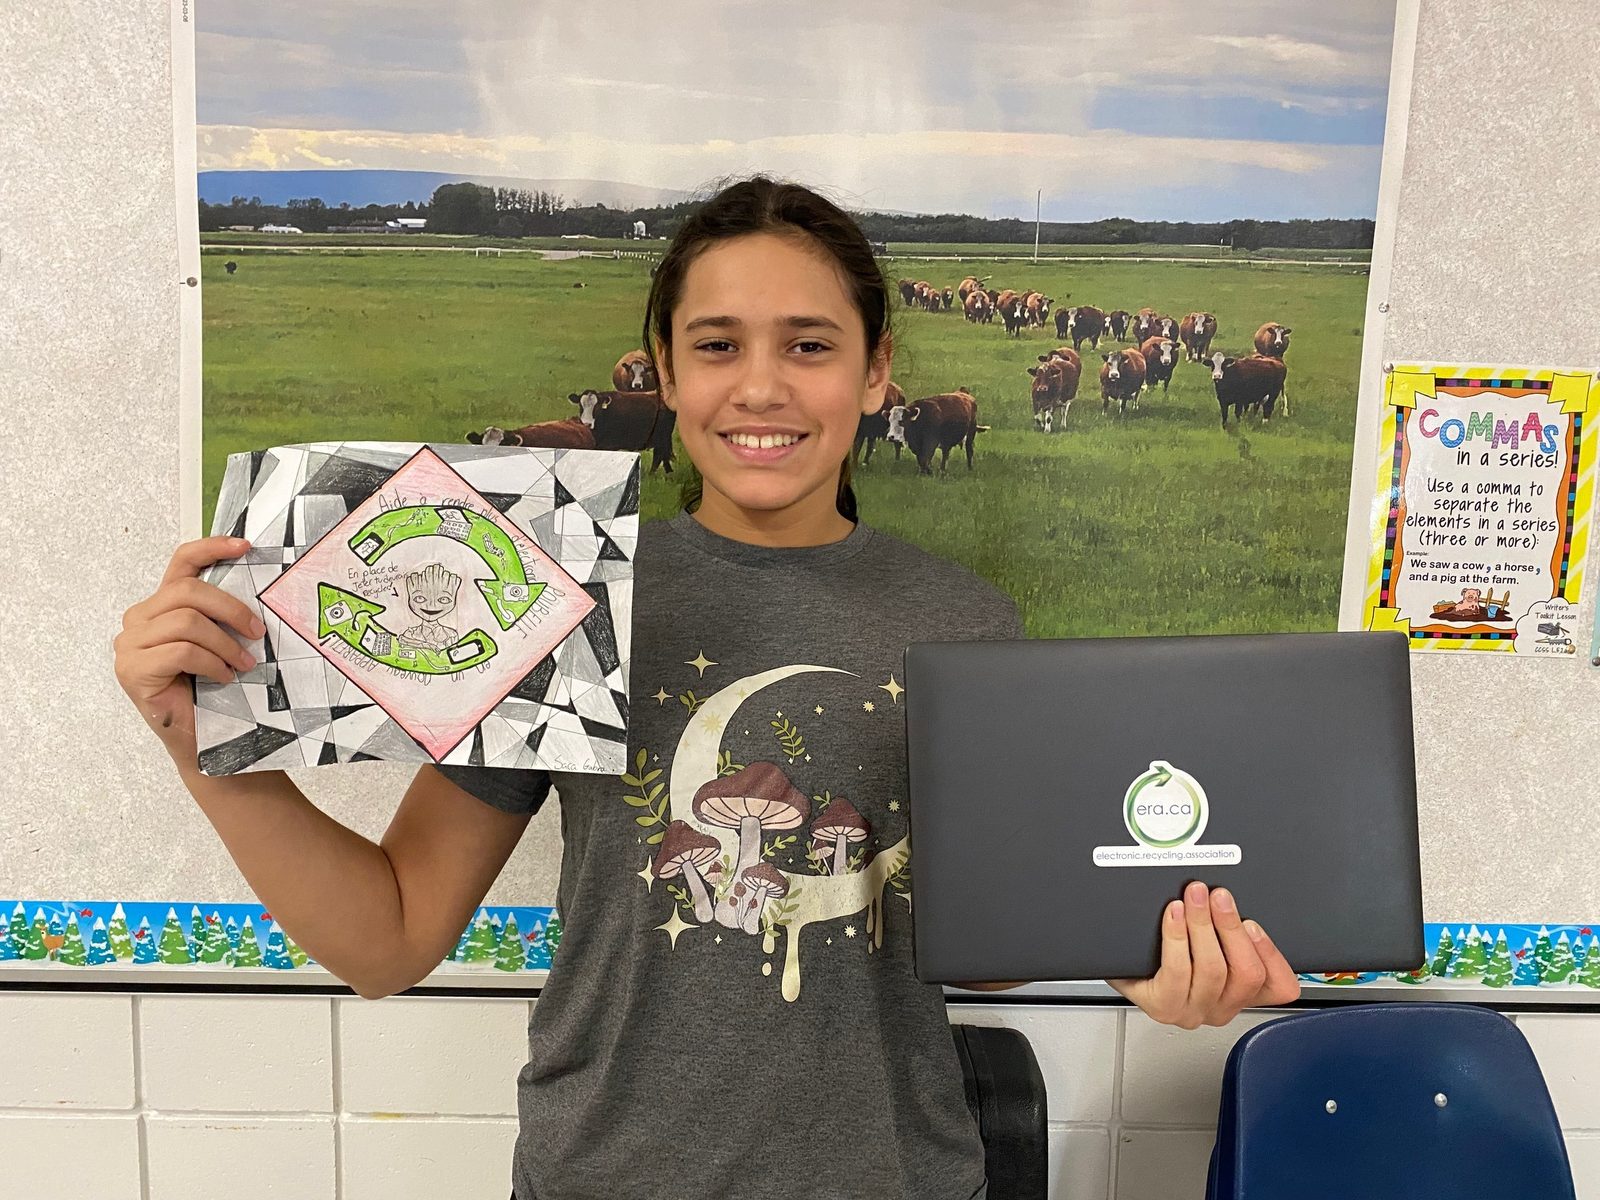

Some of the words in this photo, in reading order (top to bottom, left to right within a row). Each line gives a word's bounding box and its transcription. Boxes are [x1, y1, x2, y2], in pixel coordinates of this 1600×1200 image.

[1419, 408, 1559, 454] COMMAS
[1457, 447, 1470, 465] in
[1480, 452, 1489, 466] a
[1499, 450, 1558, 468] series!
[1427, 478, 1454, 493] Use
[1461, 482, 1469, 494] a
[1477, 482, 1521, 496] comma
[1530, 481, 1543, 497] to
[379, 489, 408, 513] Aide
[442, 495, 475, 509] rendre
[1434, 497, 1499, 515] separate
[1507, 498, 1533, 513] the
[1406, 513, 1471, 529] elements
[1478, 515, 1490, 530] in
[1497, 519, 1505, 530] a
[1512, 517, 1556, 532] series
[1419, 530, 1467, 546] (three
[1474, 535, 1489, 547] or
[362, 566, 386, 582] place
[387, 561, 398, 573] de
[1411, 559, 1427, 569] We
[1429, 562, 1451, 570] saw
[1453, 562, 1459, 570] a
[1495, 563, 1501, 571] a
[1409, 573, 1429, 581] and
[1431, 574, 1438, 582] a
[1440, 573, 1457, 584] pig
[1460, 574, 1470, 583] at
[1472, 574, 1490, 584] the
[1492, 575, 1519, 585] farm.
[1535, 611, 1554, 620] Toolkit
[1136, 804, 1192, 816] era.ca
